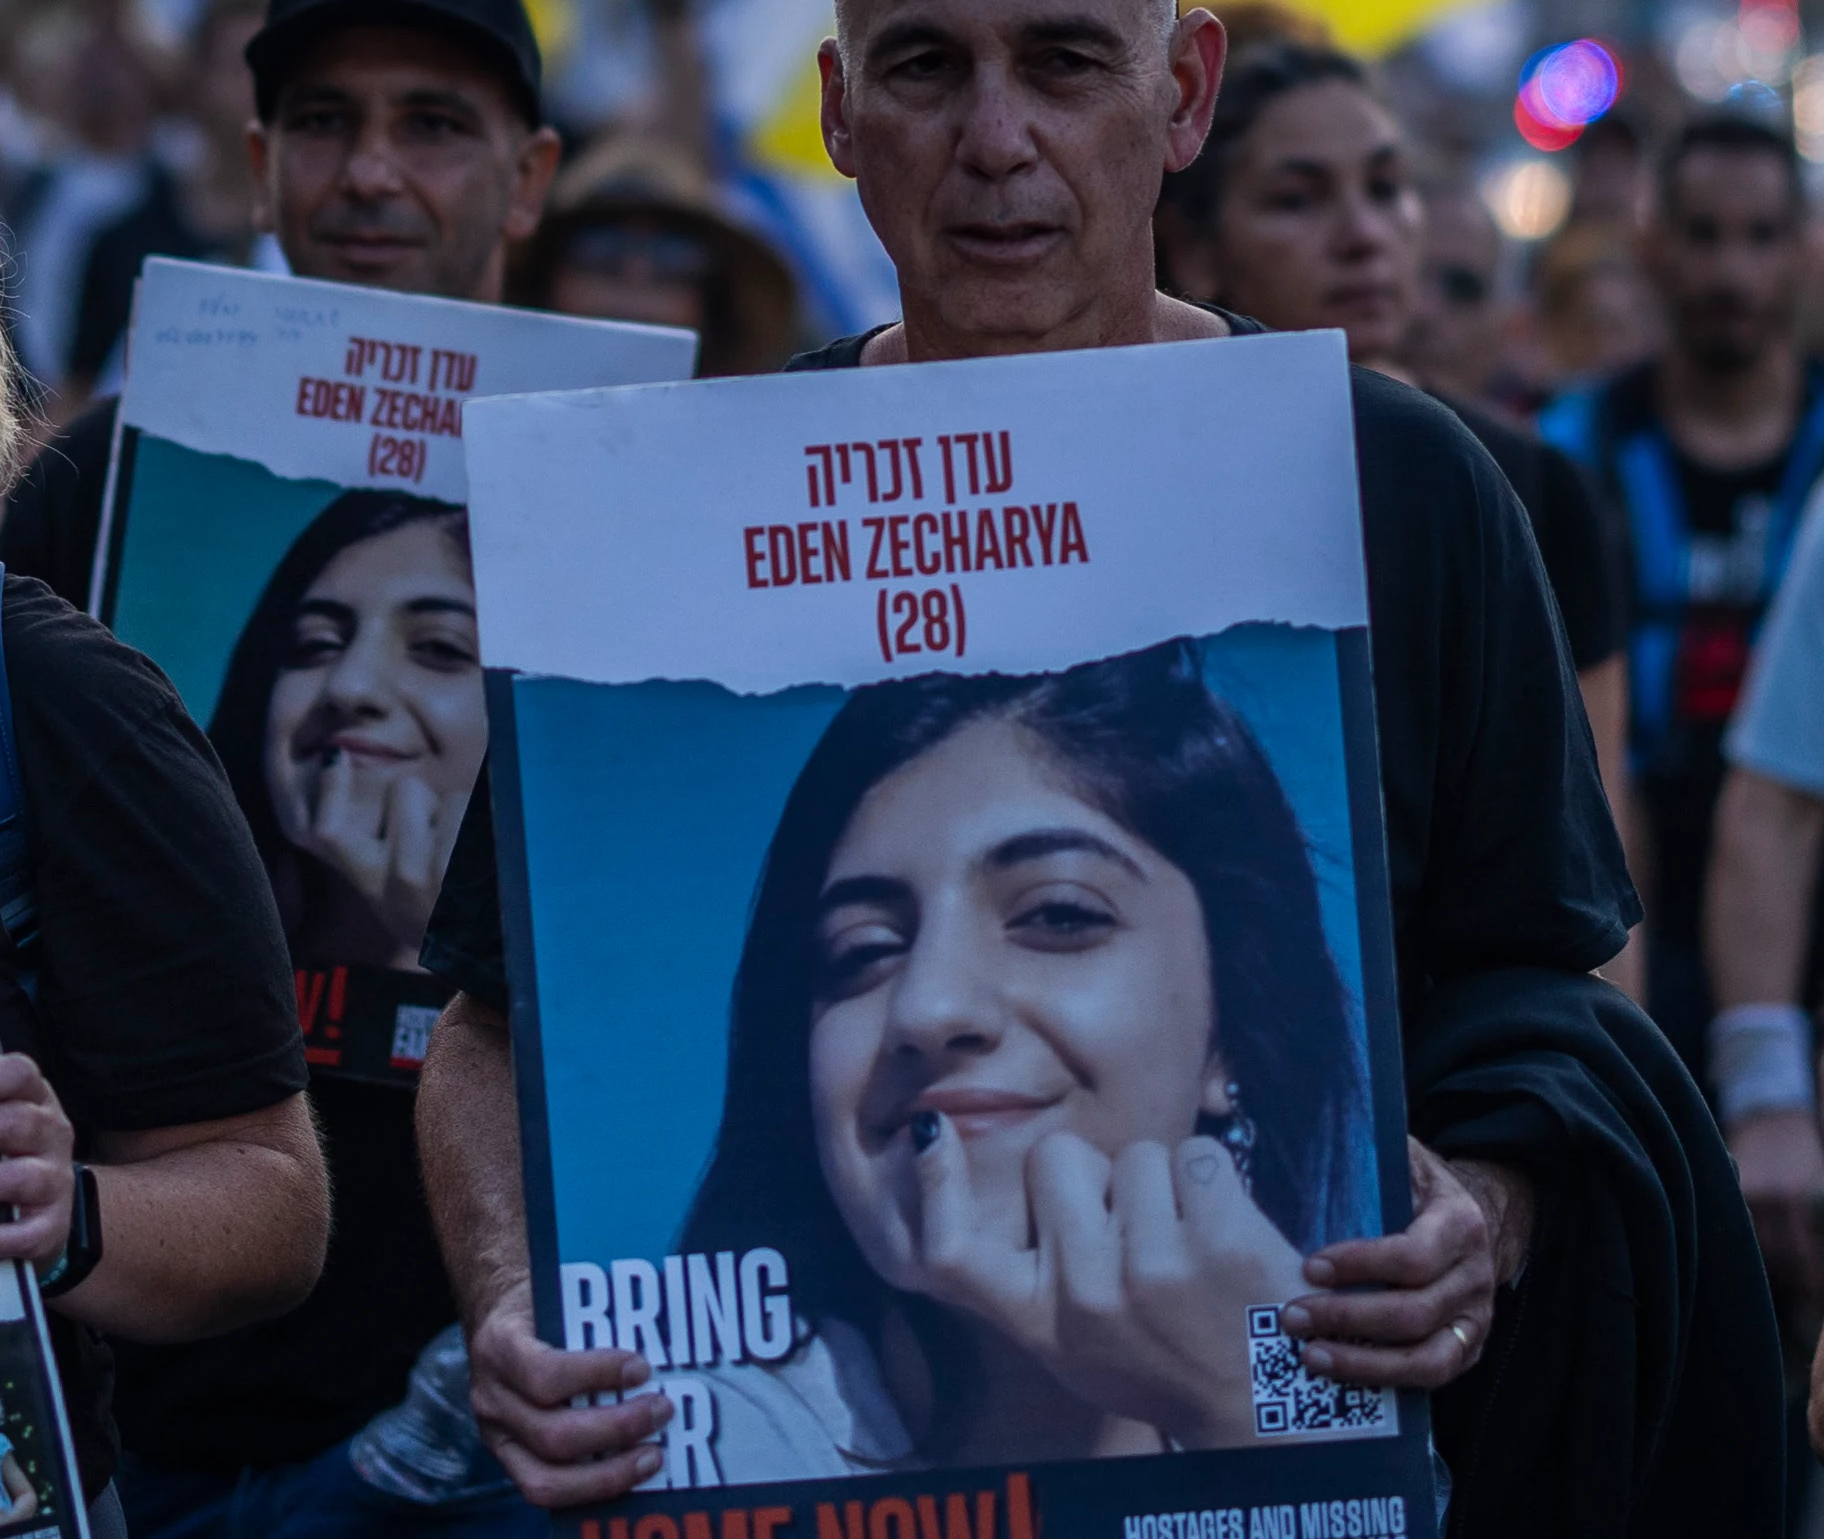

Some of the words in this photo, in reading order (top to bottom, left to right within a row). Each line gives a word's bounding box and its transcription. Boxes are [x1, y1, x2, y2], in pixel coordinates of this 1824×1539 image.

[344, 336, 423, 385] זכריה
[428, 346, 478, 392] עדן
[295, 376, 366, 424] EDEN
[369, 387, 462, 439] ZECHA
[368, 433, 426, 484] (28)
[803, 437, 924, 508] זכריה
[937, 429, 1014, 504] עדן
[743, 518, 852, 589] EDEN
[861, 501, 1090, 579] ZECHARYA
[876, 583, 966, 663] (28)
[559, 1247, 794, 1372] BRING
[1248, 1505, 1298, 1539] AND
[1299, 1495, 1406, 1539] MISSING
